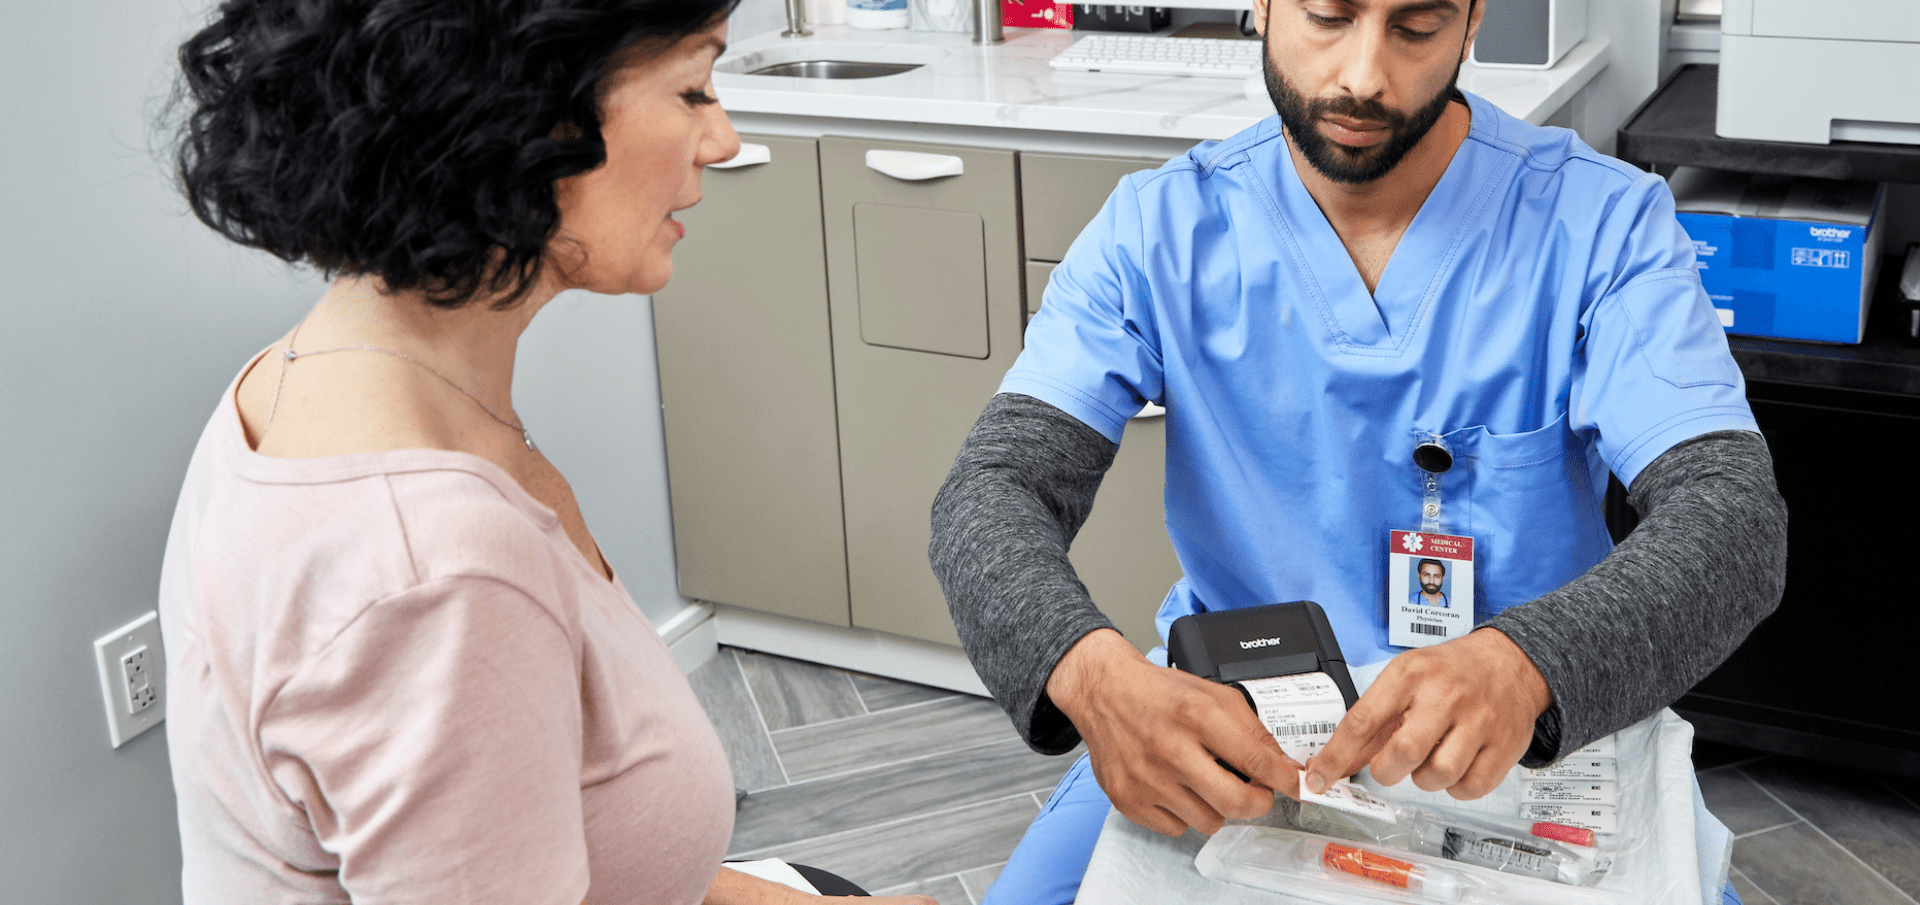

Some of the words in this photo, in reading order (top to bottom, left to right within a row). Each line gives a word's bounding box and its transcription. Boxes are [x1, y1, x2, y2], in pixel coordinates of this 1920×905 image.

[1810, 226, 1851, 238] brother
[1430, 538, 1461, 547] MEDICAL
[1430, 546, 1457, 554] CENTER
[1401, 605, 1423, 614] David
[1425, 608, 1460, 618] Corcoran
[1416, 615, 1444, 623] Physician
[1239, 637, 1281, 649] brother
